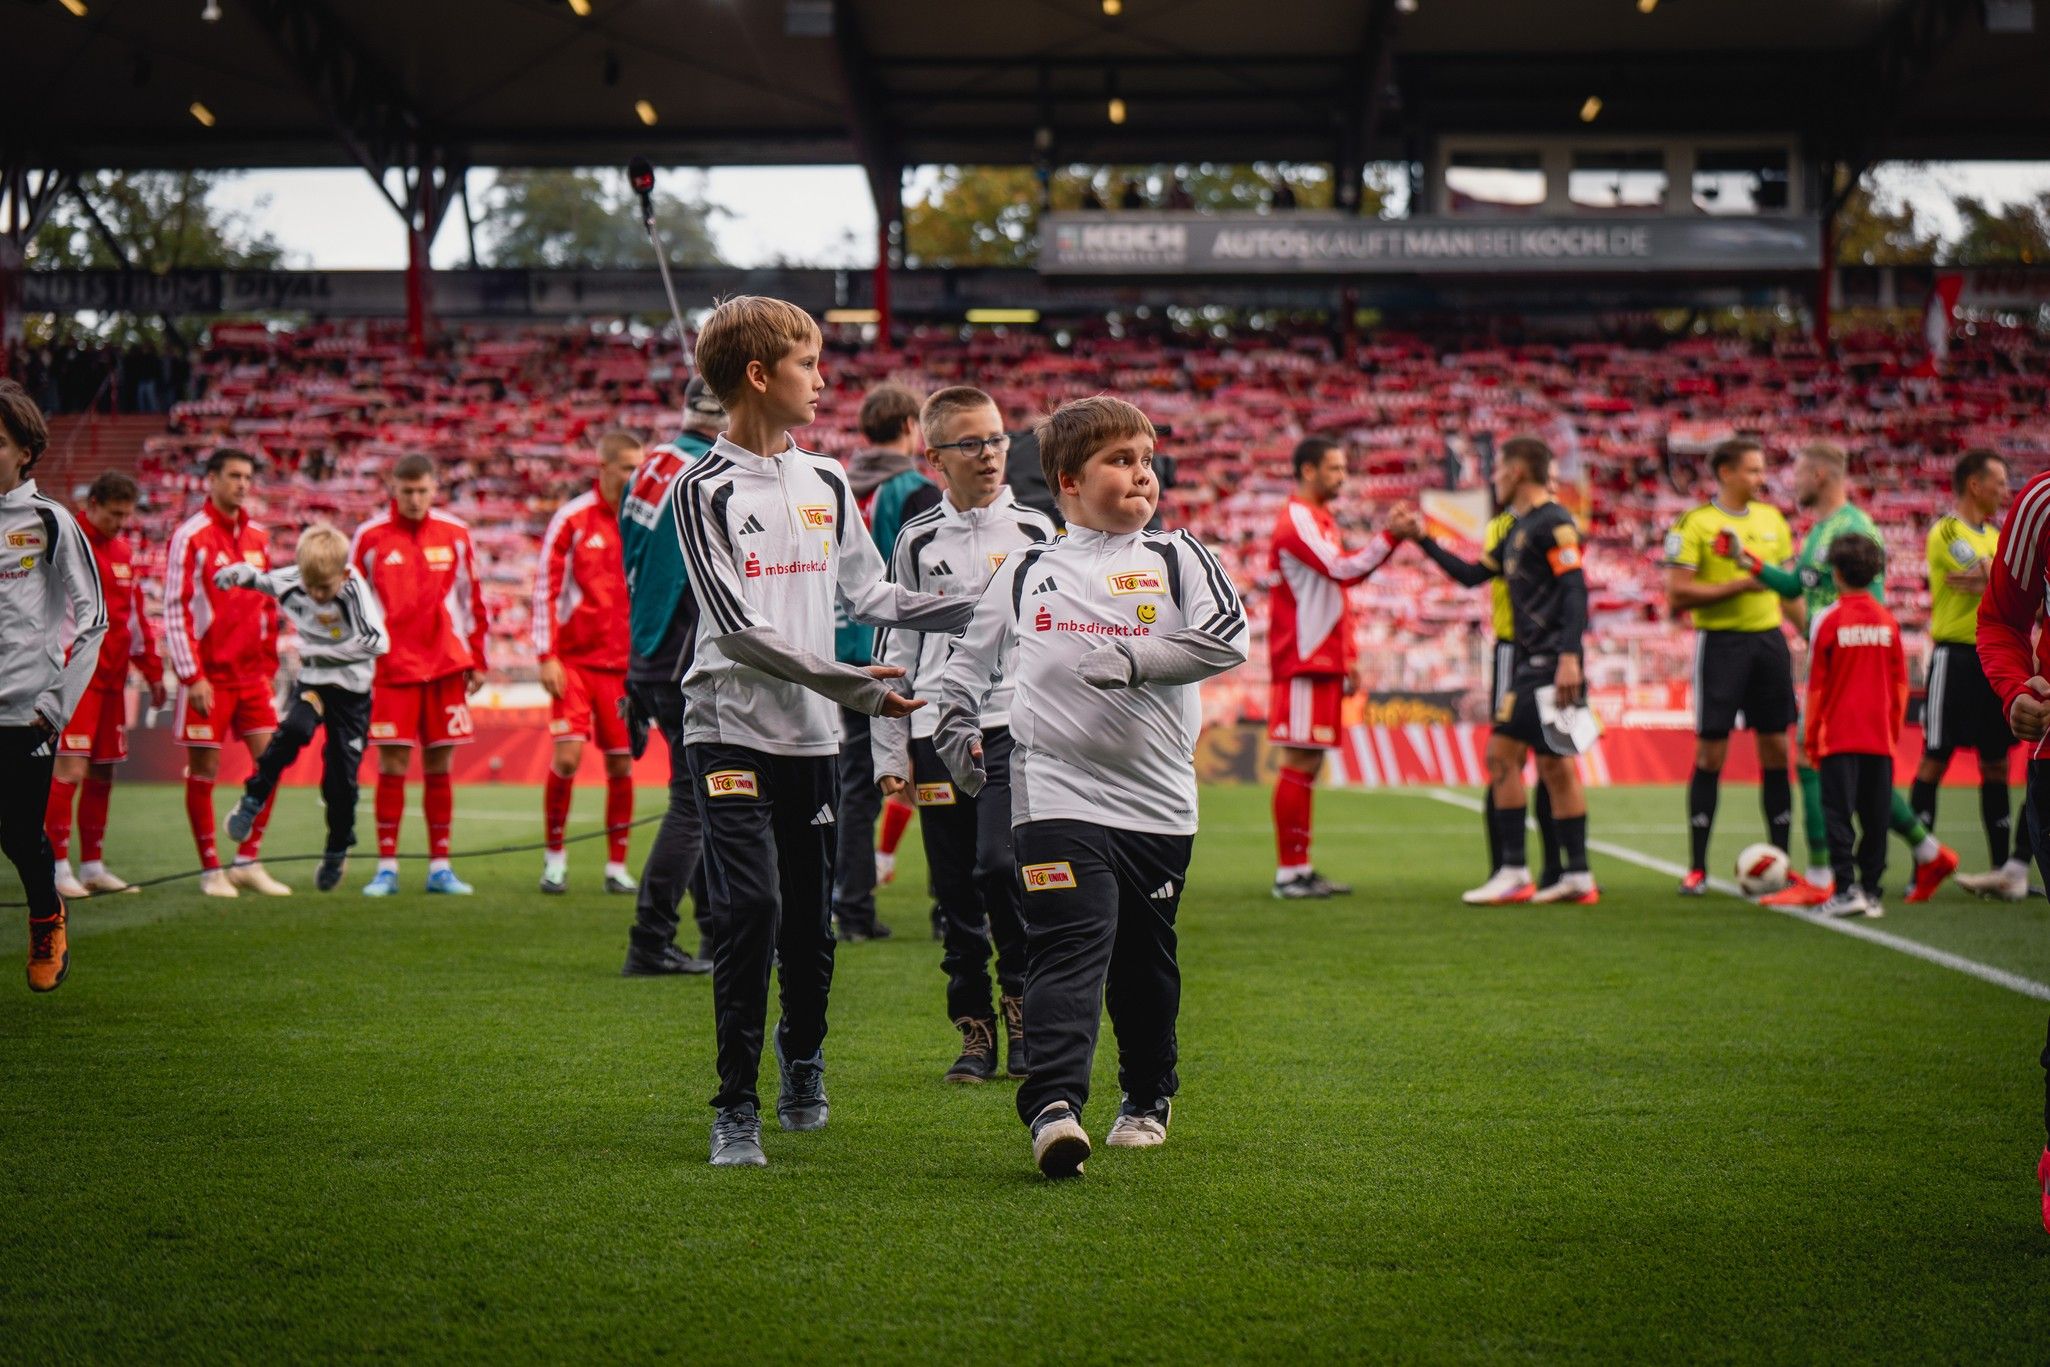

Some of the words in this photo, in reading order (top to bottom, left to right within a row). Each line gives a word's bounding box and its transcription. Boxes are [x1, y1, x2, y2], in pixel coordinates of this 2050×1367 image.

[765, 560, 827, 576] mbsdirekt.d
[1138, 579, 1160, 588] UNION
[1057, 620, 1149, 636] mbsdirekt.de
[1837, 624, 1893, 648] REWE
[445, 703, 474, 737] 20
[735, 779, 754, 790] UNION
[1048, 872, 1069, 882] UNION
